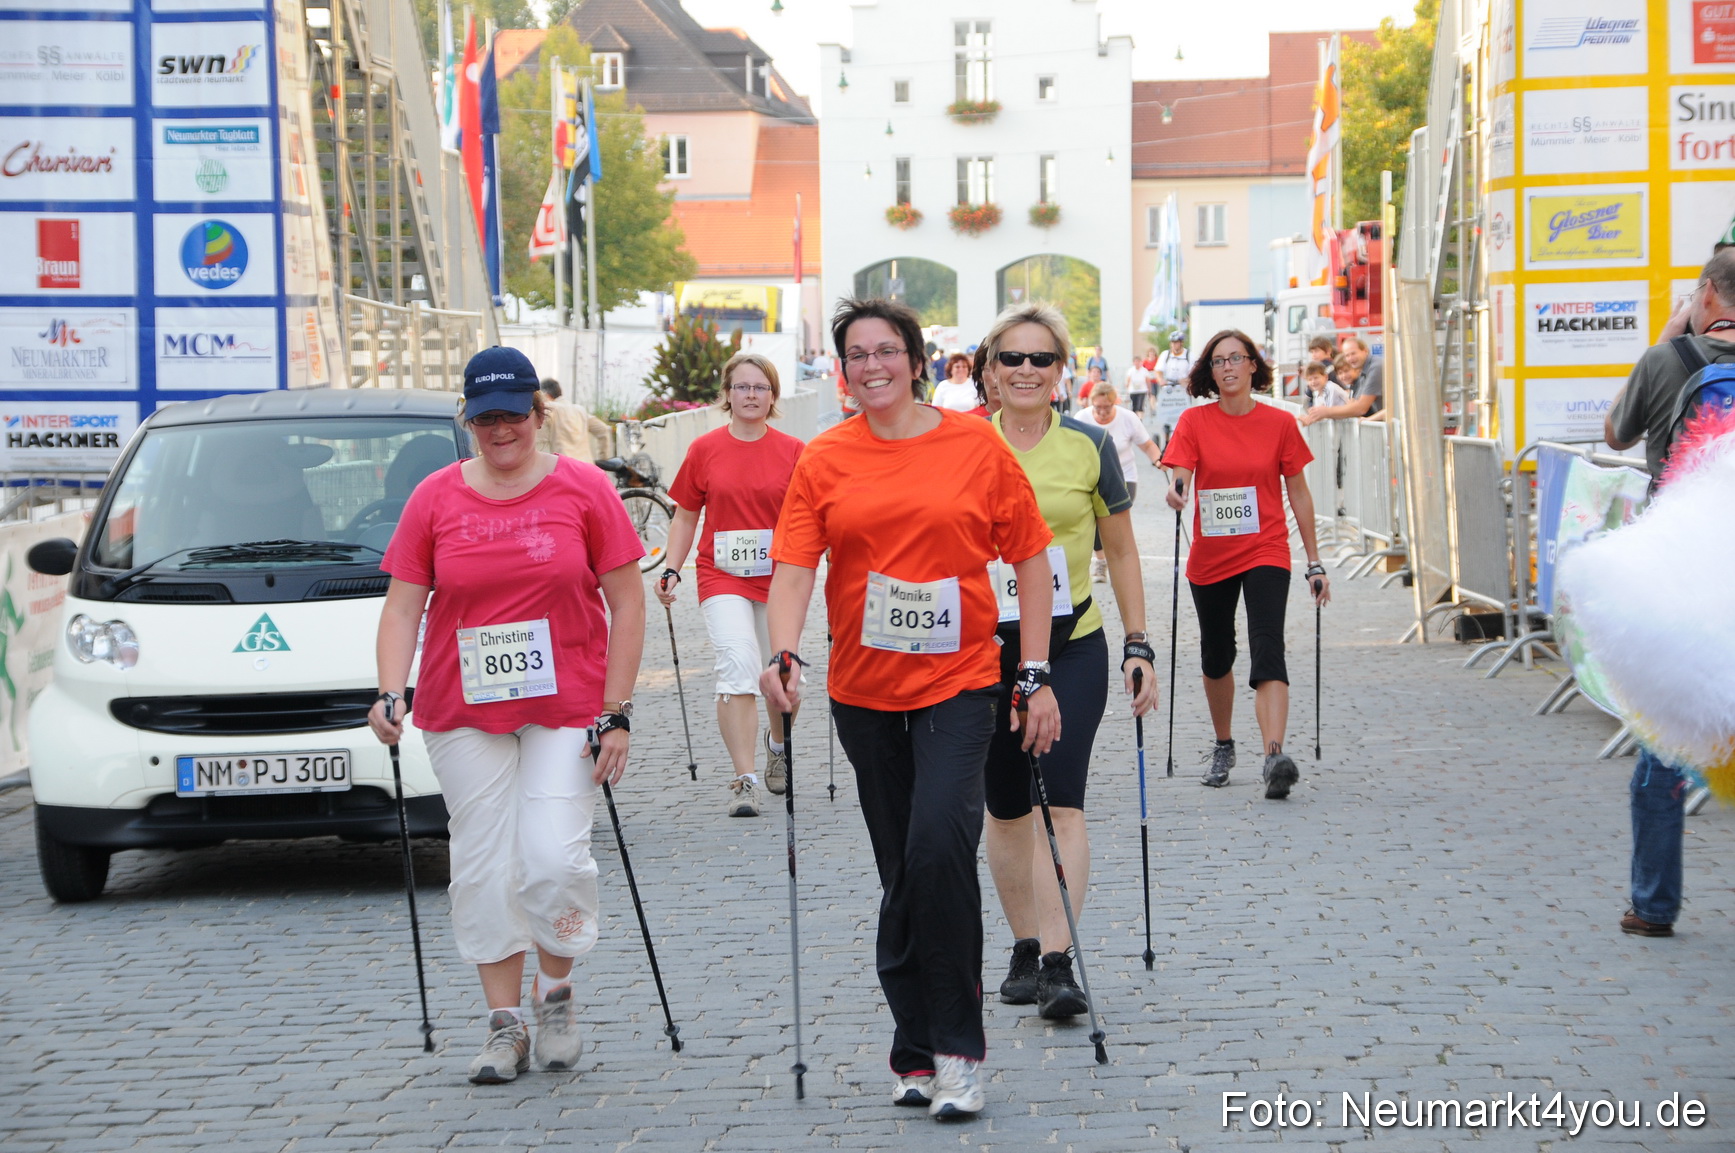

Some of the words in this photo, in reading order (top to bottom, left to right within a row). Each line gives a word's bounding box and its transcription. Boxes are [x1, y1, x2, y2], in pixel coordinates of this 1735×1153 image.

[1585, 17, 1639, 32] Wagner
[157, 54, 226, 75] swn
[52, 70, 85, 80] Meier
[156, 76, 201, 84] stadtwerke
[204, 75, 244, 84] neumarkt
[167, 130, 217, 140] Neumarkter
[218, 129, 254, 142] Tagblatt
[1584, 135, 1610, 144] Meier
[1, 139, 116, 177] Charivari
[1548, 202, 1623, 243] Glossner
[1587, 224, 1622, 241] Bier
[36, 256, 77, 275] Braun
[188, 265, 241, 281] vedes
[1553, 300, 1639, 315] INTERSPORT
[1538, 316, 1638, 332] HACKNER
[163, 333, 234, 356] MCM
[11, 346, 108, 367] NEUMARKTER
[22, 368, 97, 379] MINERALBRUNNEN
[22, 415, 119, 428] INTERSPORT
[6, 432, 119, 448] HACKNER
[1213, 493, 1247, 502] Christina
[1216, 505, 1252, 519] 8068
[736, 536, 757, 545] Moni
[731, 547, 767, 561] 8115
[889, 584, 932, 602] Monika
[890, 608, 951, 629] 8034
[480, 629, 535, 647] Christine
[485, 650, 543, 675] 8033
[197, 760, 232, 786] NM
[254, 758, 288, 784] PJ
[295, 756, 346, 782] 300
